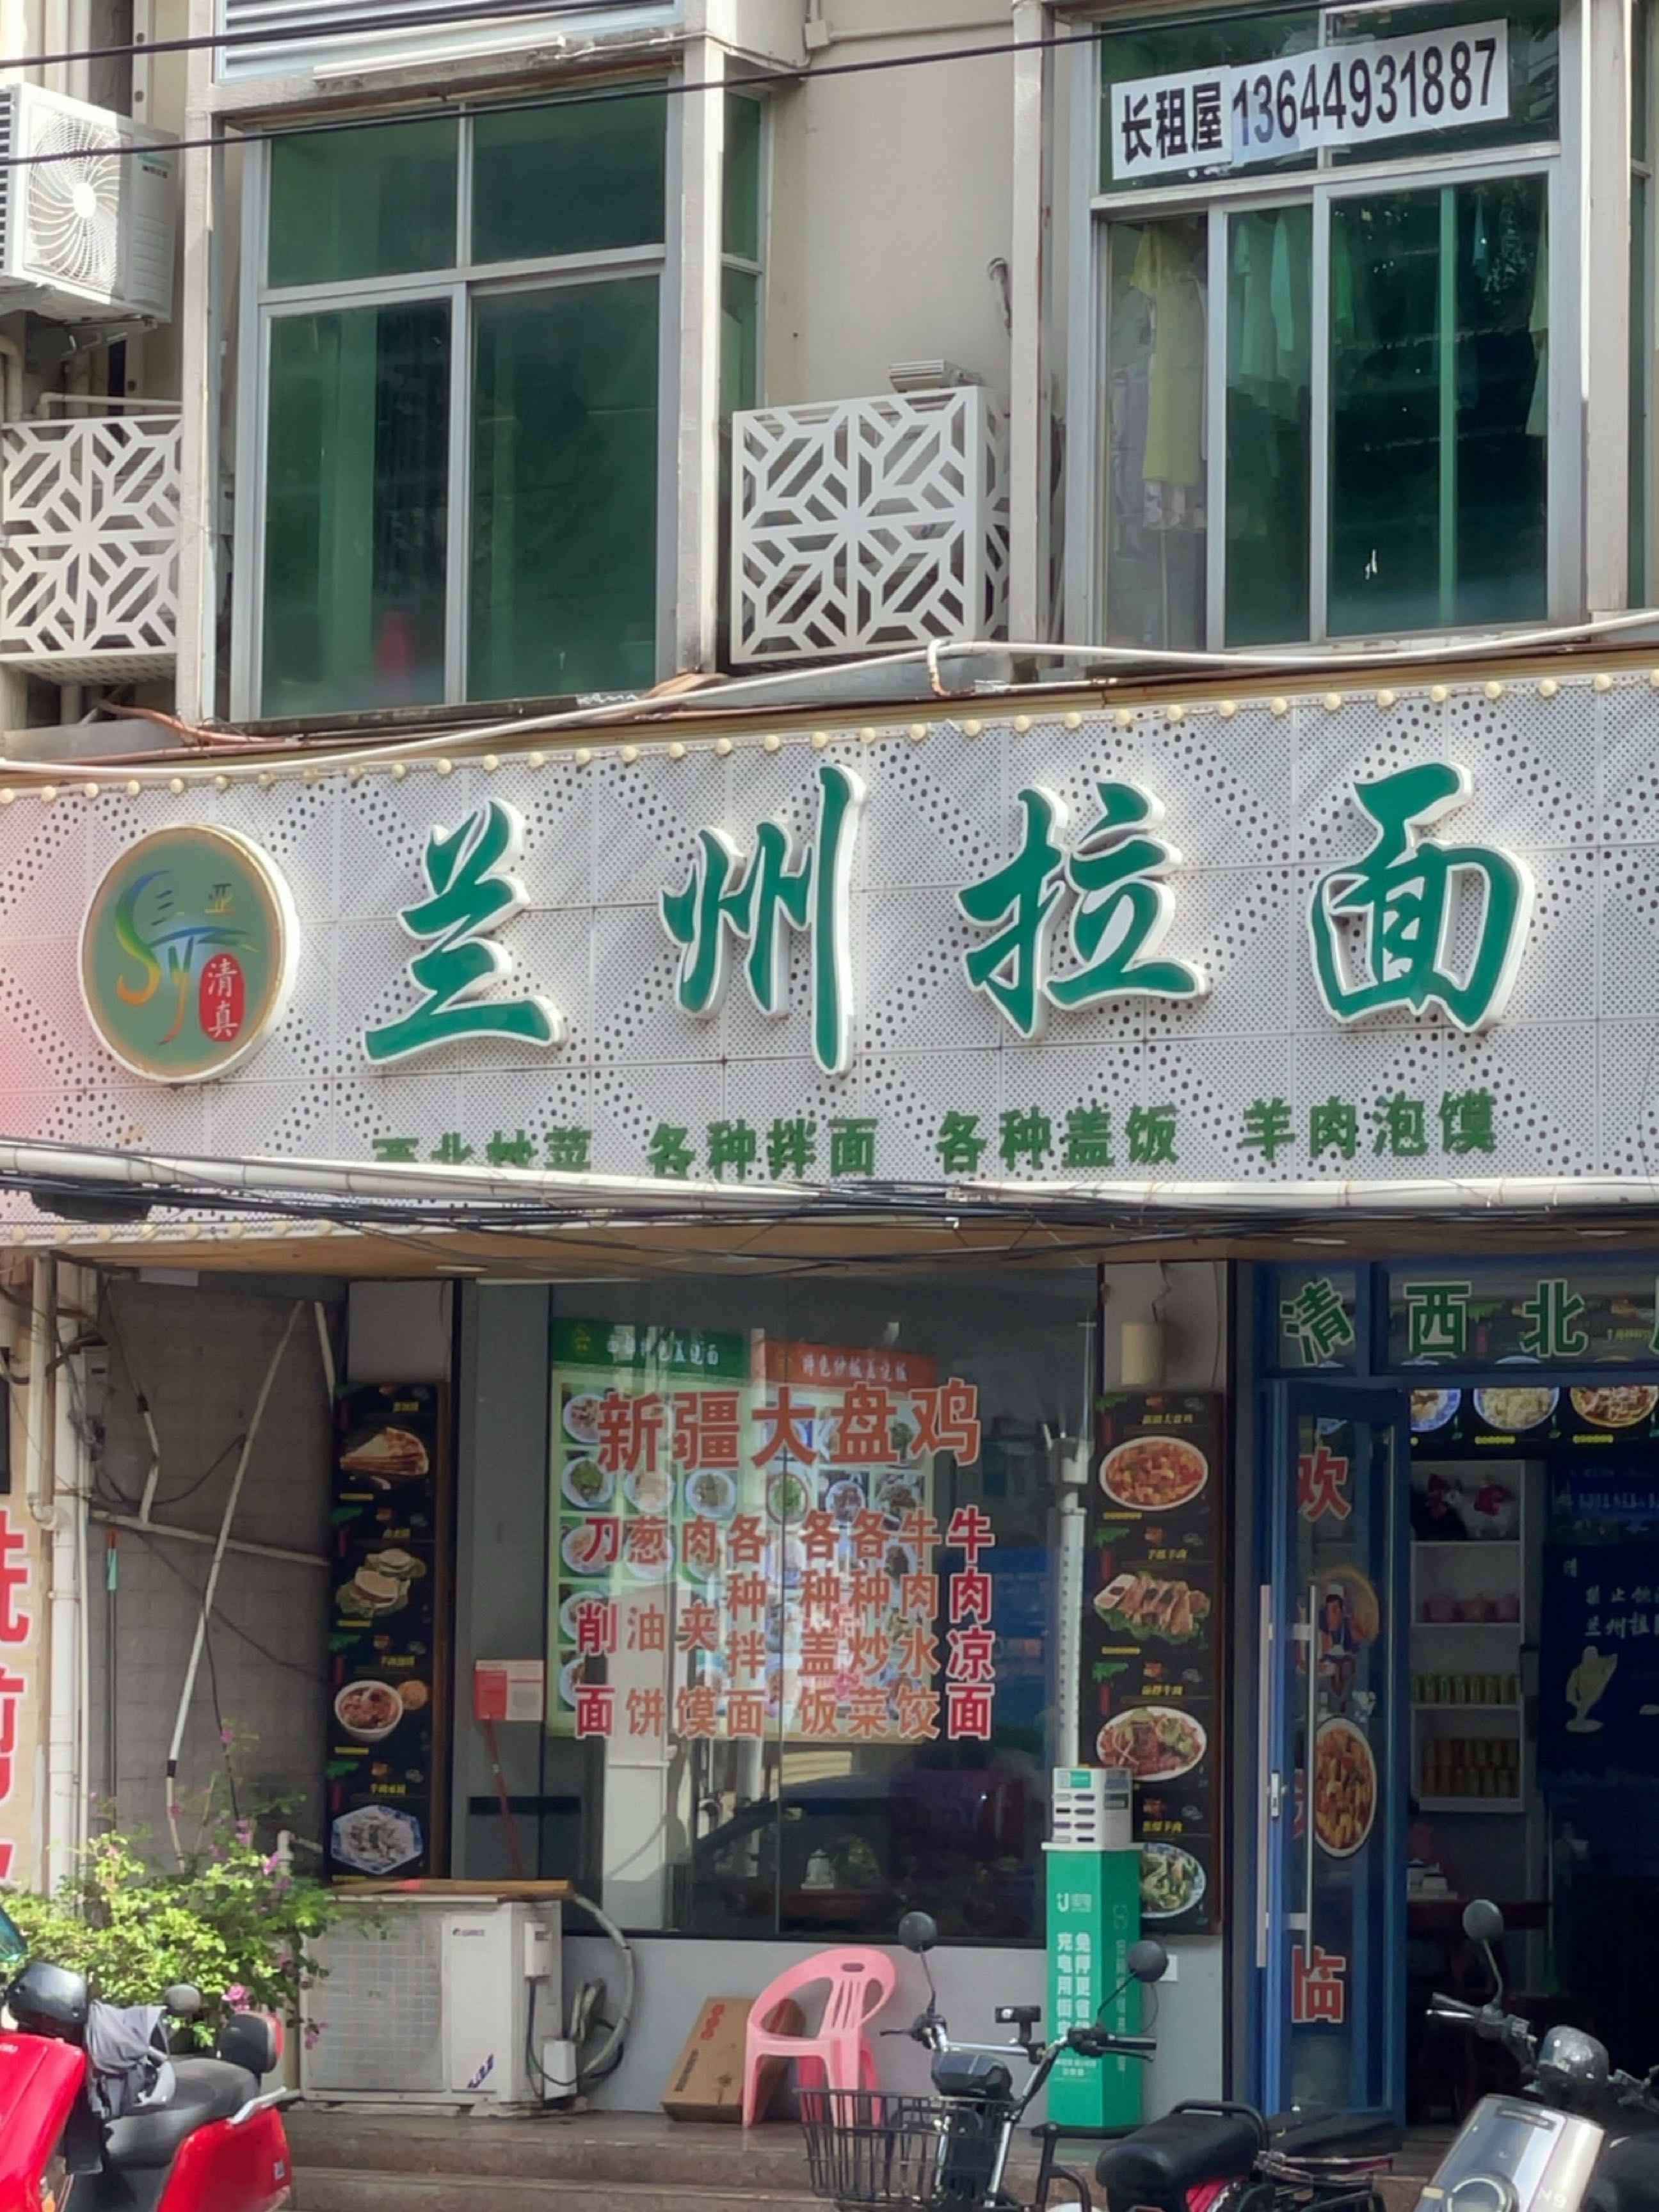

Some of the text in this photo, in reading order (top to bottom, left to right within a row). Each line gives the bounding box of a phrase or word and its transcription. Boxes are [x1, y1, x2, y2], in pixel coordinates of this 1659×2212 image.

[1121, 38, 1497, 165] 长租屋 13644931887
[206, 959, 239, 1038] 清真
[365, 762, 1536, 1075] 兰州拉面
[648, 1118, 879, 1180] 各种拌面
[935, 1103, 1180, 1174] 各种盖饭
[1238, 1088, 1498, 1162] 羊肉泡馍
[597, 1378, 981, 1472] 新疆大盘鸡
[1281, 1278, 1354, 1367] 清
[1405, 1278, 1659, 1359] 西北
[575, 1516, 621, 1738] 刀削面
[625, 1516, 669, 1738] 葱油饼
[675, 1514, 717, 1738] 肉夹馍
[725, 1512, 769, 1738] 各种拌面
[797, 1507, 841, 1737] 各种盖饭
[847, 1507, 891, 1738] 各种炒菜
[896, 1507, 942, 1740] 牛肉水饺
[945, 1504, 995, 1740] 牛肉凉面
